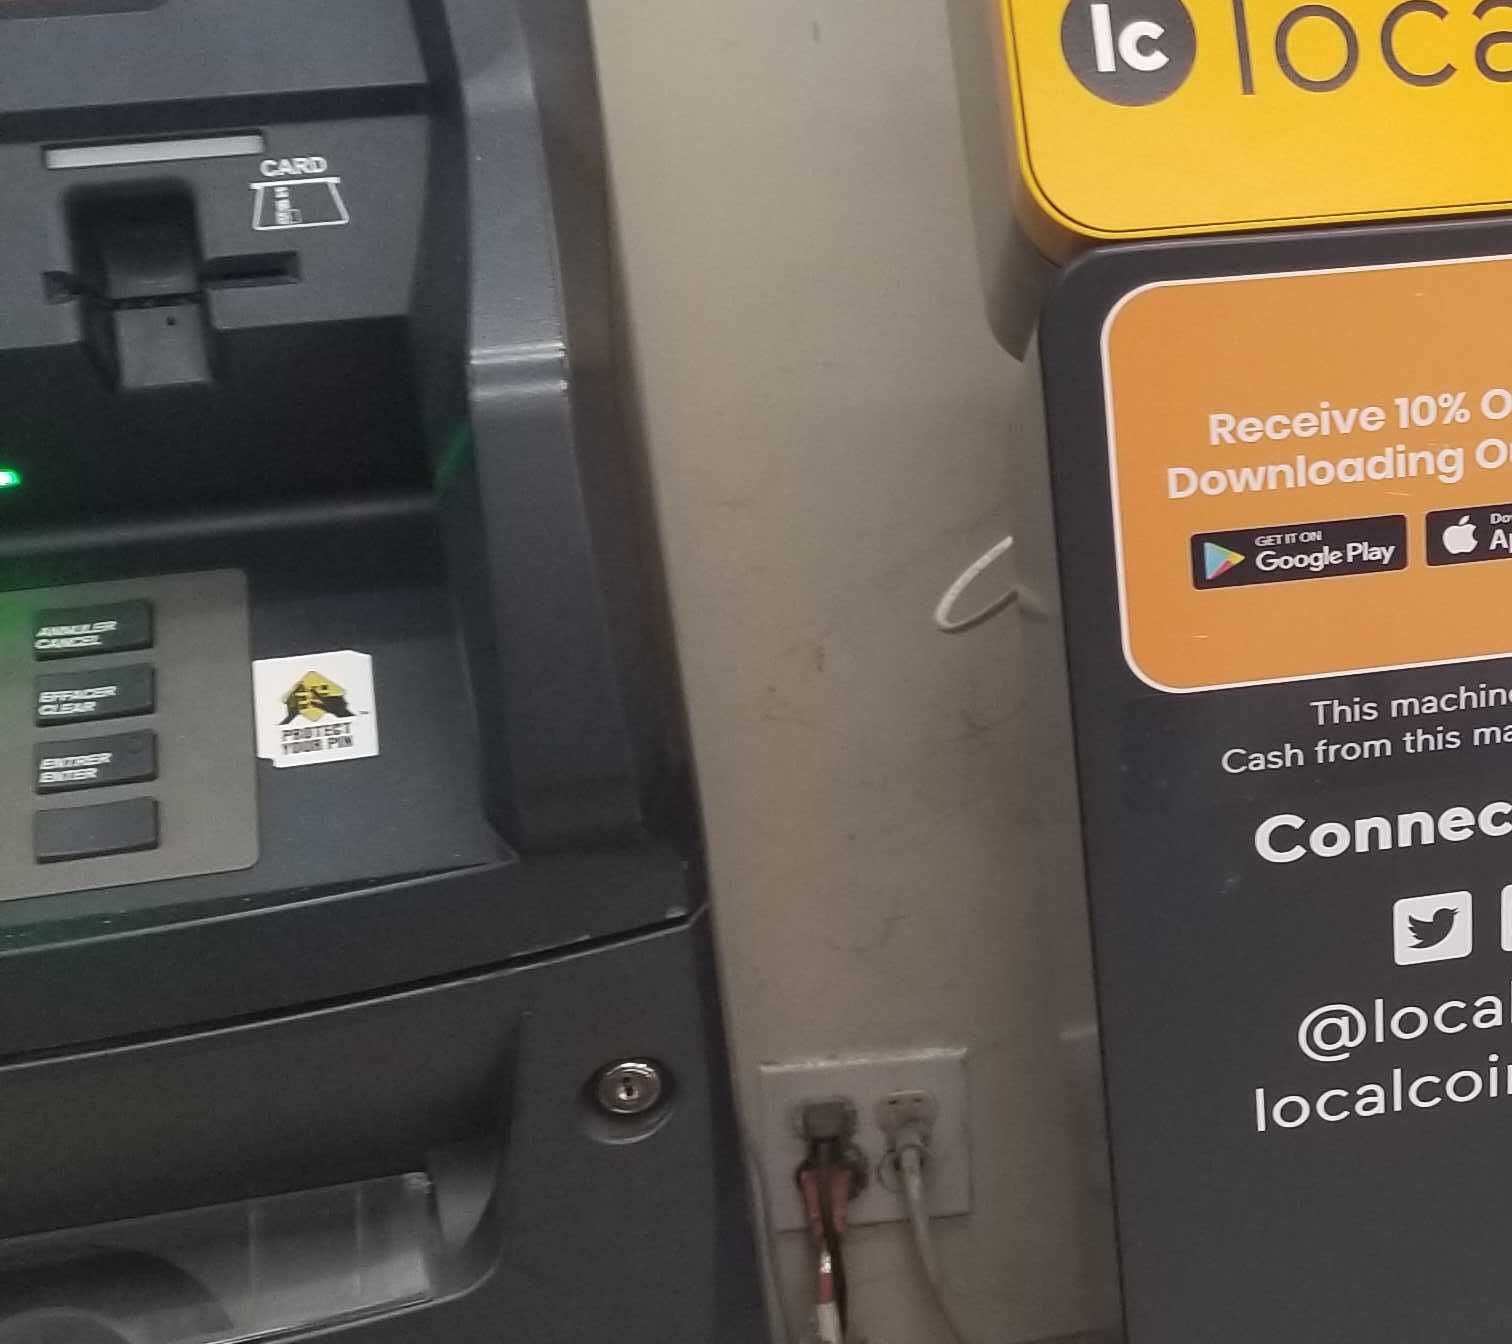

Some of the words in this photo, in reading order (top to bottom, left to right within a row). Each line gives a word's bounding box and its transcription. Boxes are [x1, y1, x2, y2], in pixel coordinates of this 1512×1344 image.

[259, 156, 328, 178] CARD
[1207, 400, 1387, 446] Receive
[1393, 390, 1472, 431] 10%
[1166, 443, 1465, 500] Downloading
[1254, 533, 1282, 549] GET
[1283, 531, 1298, 545] IT
[1299, 529, 1323, 543] ON
[1254, 545, 1344, 577] Google
[1347, 541, 1396, 567] Play
[38, 701, 97, 716] CLEAR
[1309, 698, 1378, 727] This
[282, 722, 353, 742] PROTECT
[328, 735, 354, 752] PIN
[1221, 744, 1304, 774] Cash
[1314, 735, 1392, 764] from
[1402, 725, 1462, 754] this
